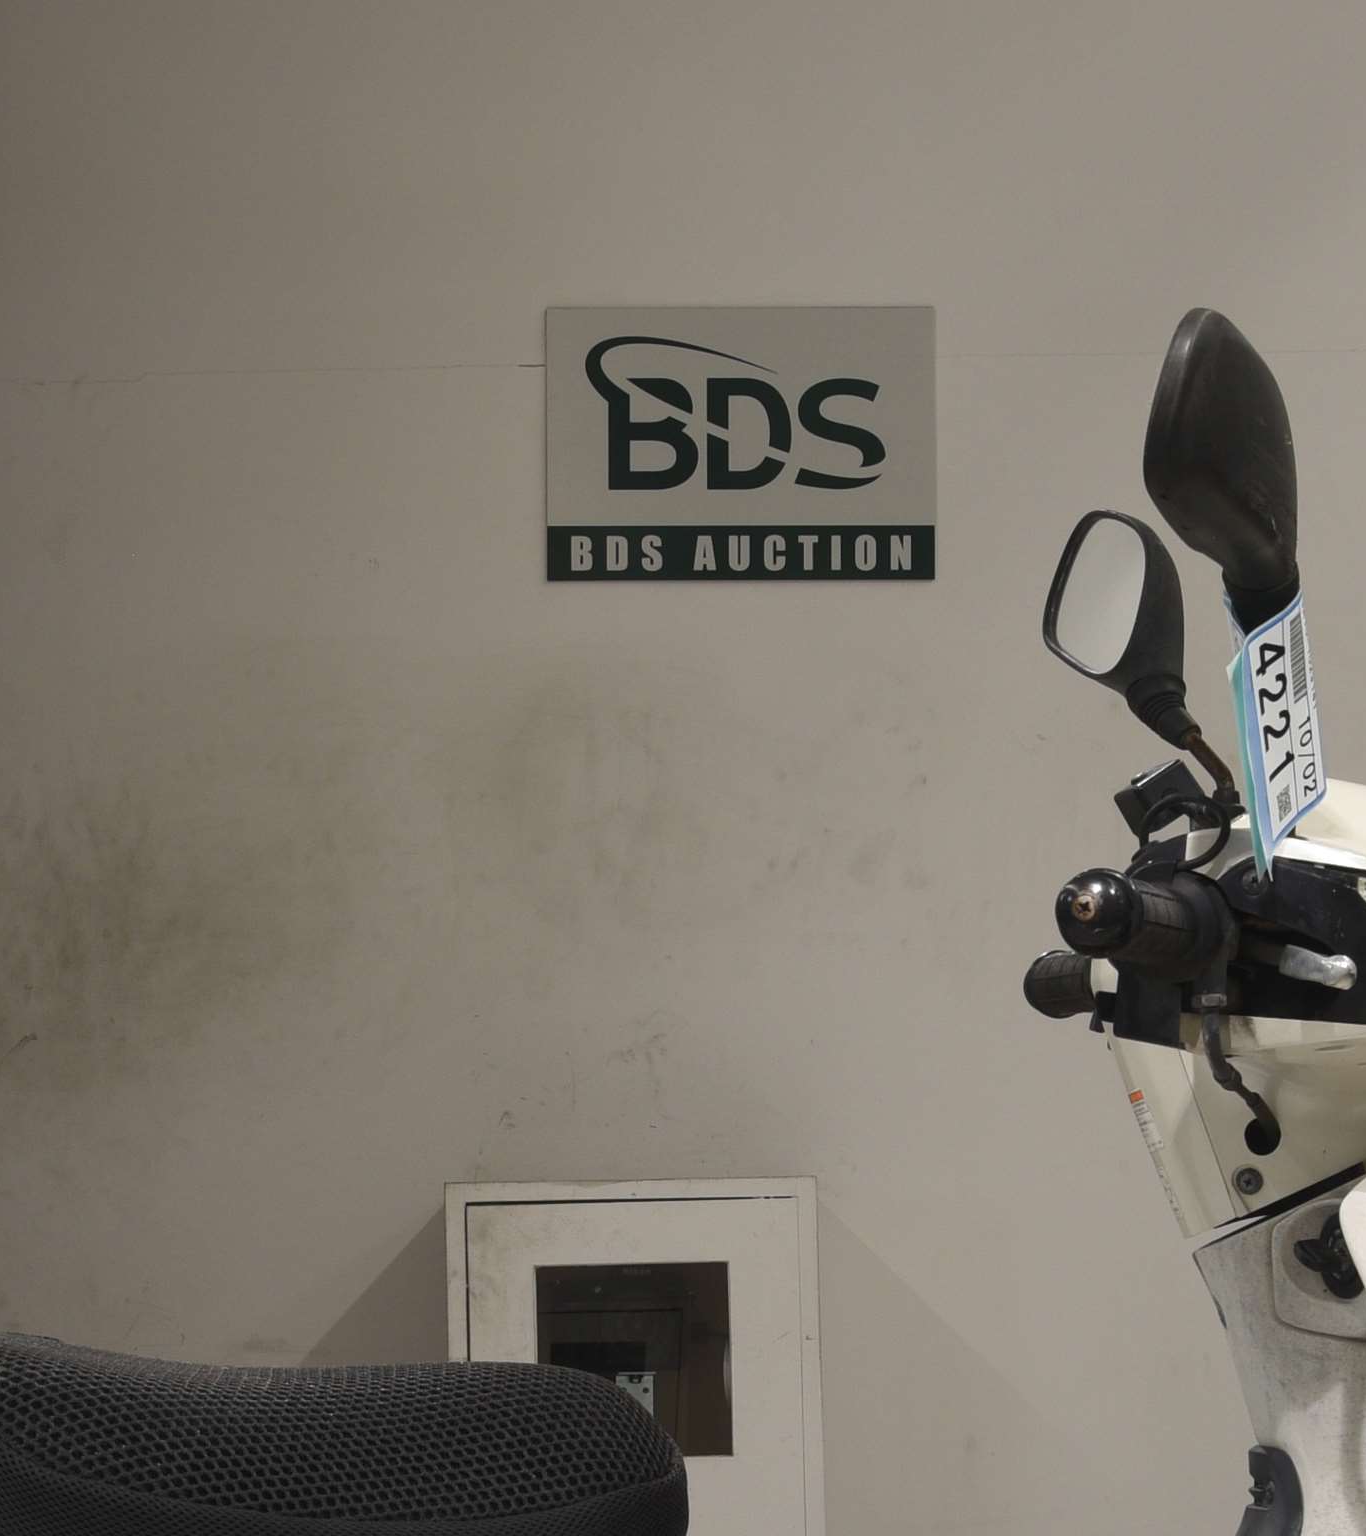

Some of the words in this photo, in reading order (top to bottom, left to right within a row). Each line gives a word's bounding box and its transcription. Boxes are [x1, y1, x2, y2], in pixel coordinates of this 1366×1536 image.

[585, 336, 887, 491] BDS
[570, 535, 663, 572] BDS
[692, 534, 913, 572] AUCTION
[1256, 642, 1295, 783] 4221
[1297, 715, 1318, 798] 10/02
